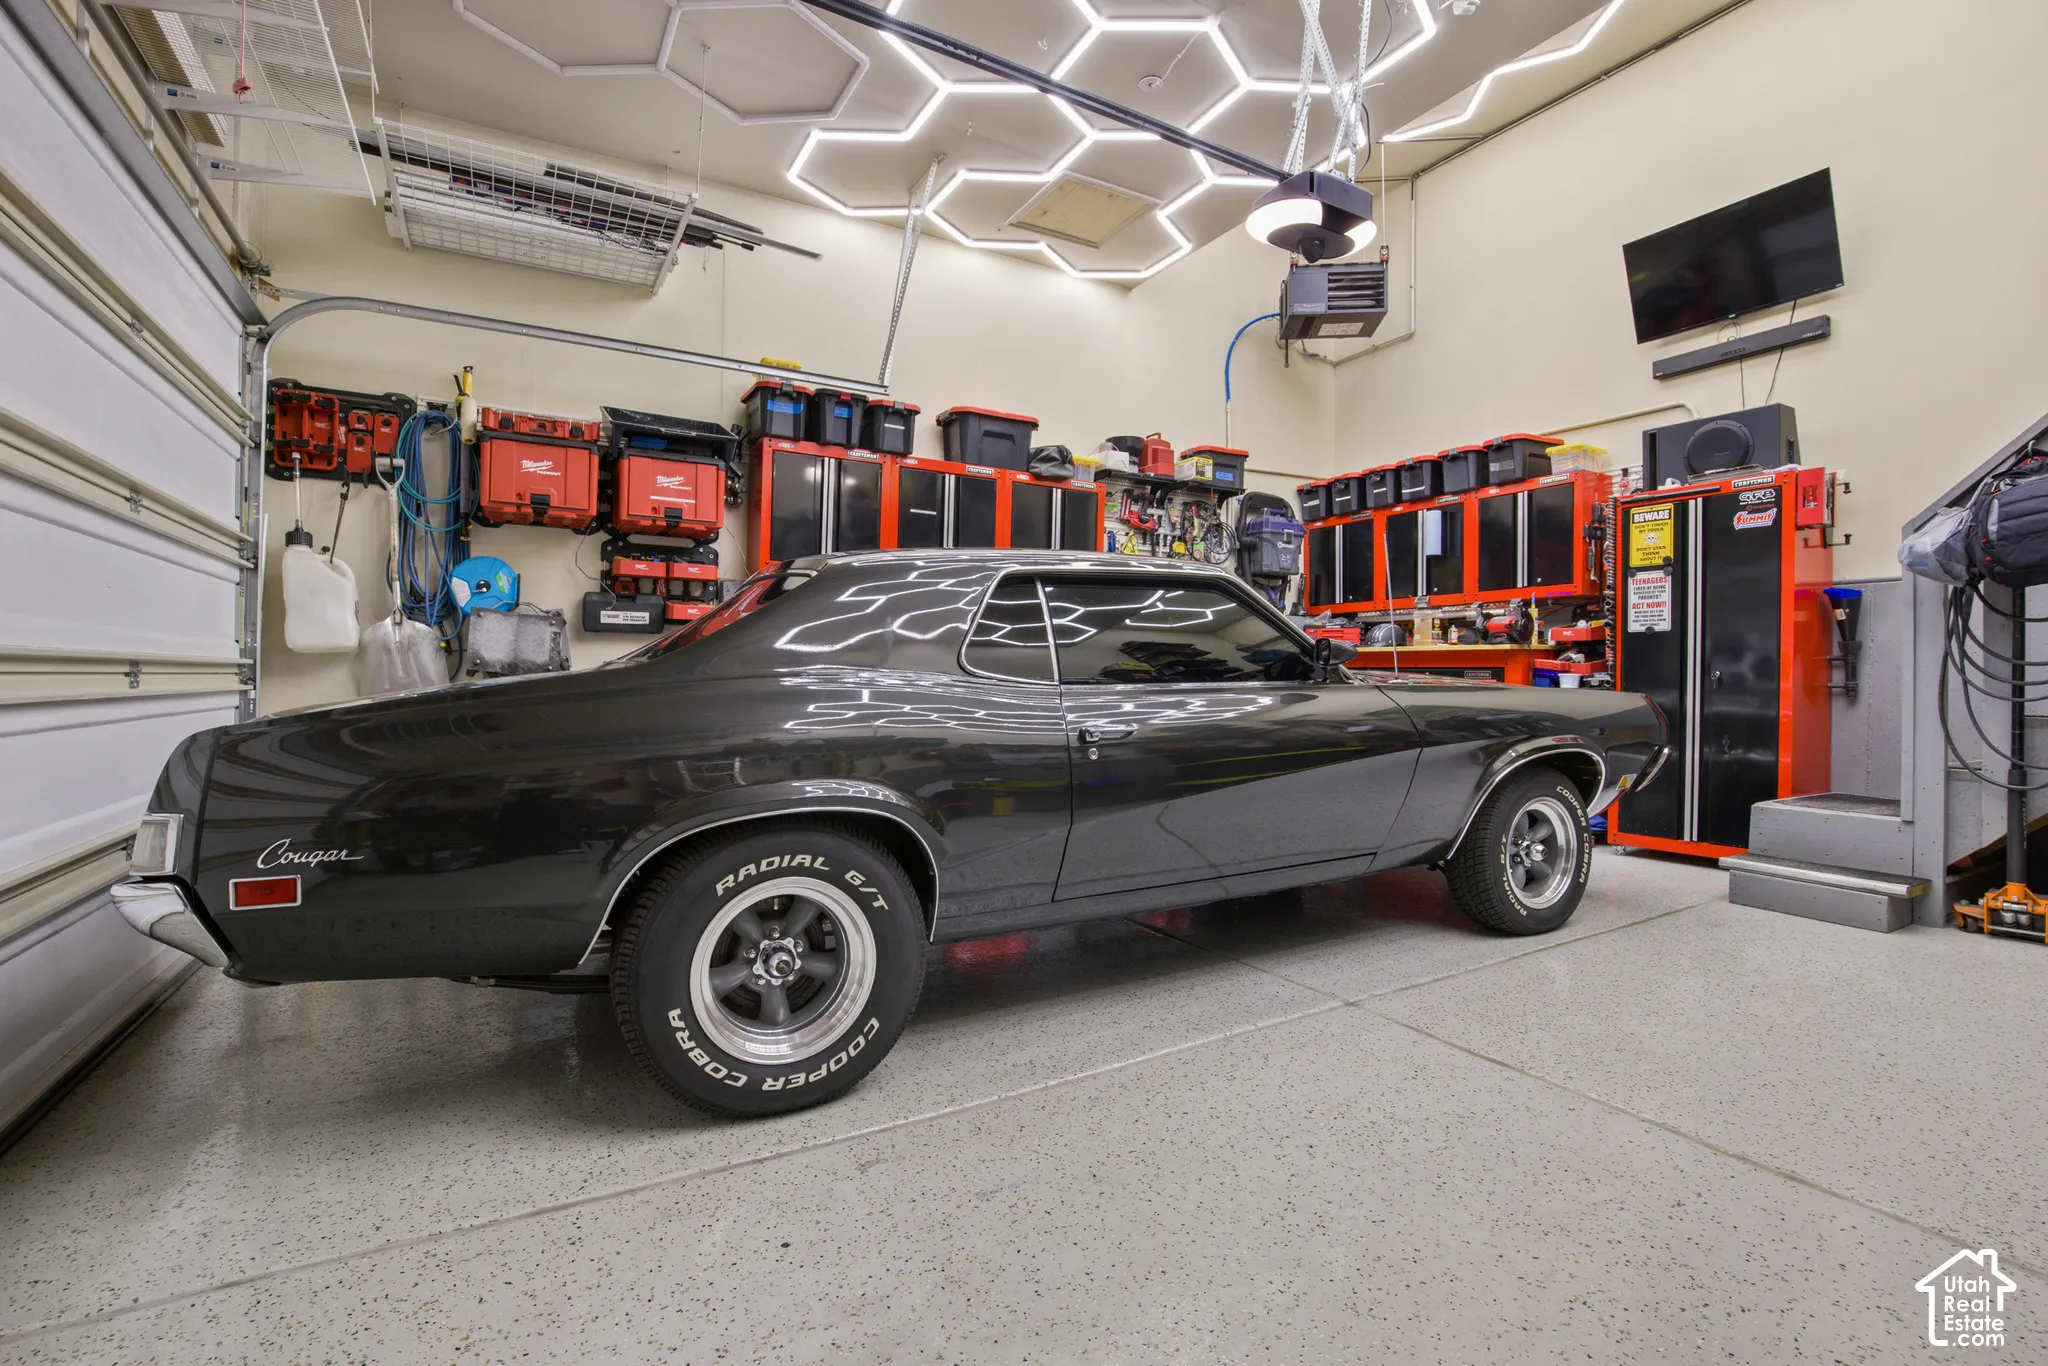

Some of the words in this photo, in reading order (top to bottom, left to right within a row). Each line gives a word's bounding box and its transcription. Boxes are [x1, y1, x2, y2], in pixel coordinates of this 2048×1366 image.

[850, 451, 877, 459] CRAFTSMAN
[967, 467, 993, 475] CRAFTSMAN
[1541, 475, 1569, 485] CRAFTSMAN
[1734, 477, 1772, 487] CRAFTSMAN
[1634, 510, 1669, 522] BEWARE
[1632, 576, 1668, 585] TEENAGERS
[1556, 785, 1586, 827] COOPER
[1578, 832, 1590, 884] COBRA
[256, 838, 364, 869] Cougar
[715, 854, 831, 898] RADIAL
[844, 869, 889, 912] G/T
[1502, 871, 1528, 917] RADIAL
[667, 1007, 748, 1088] COBRA
[761, 1016, 880, 1091] COOPER
